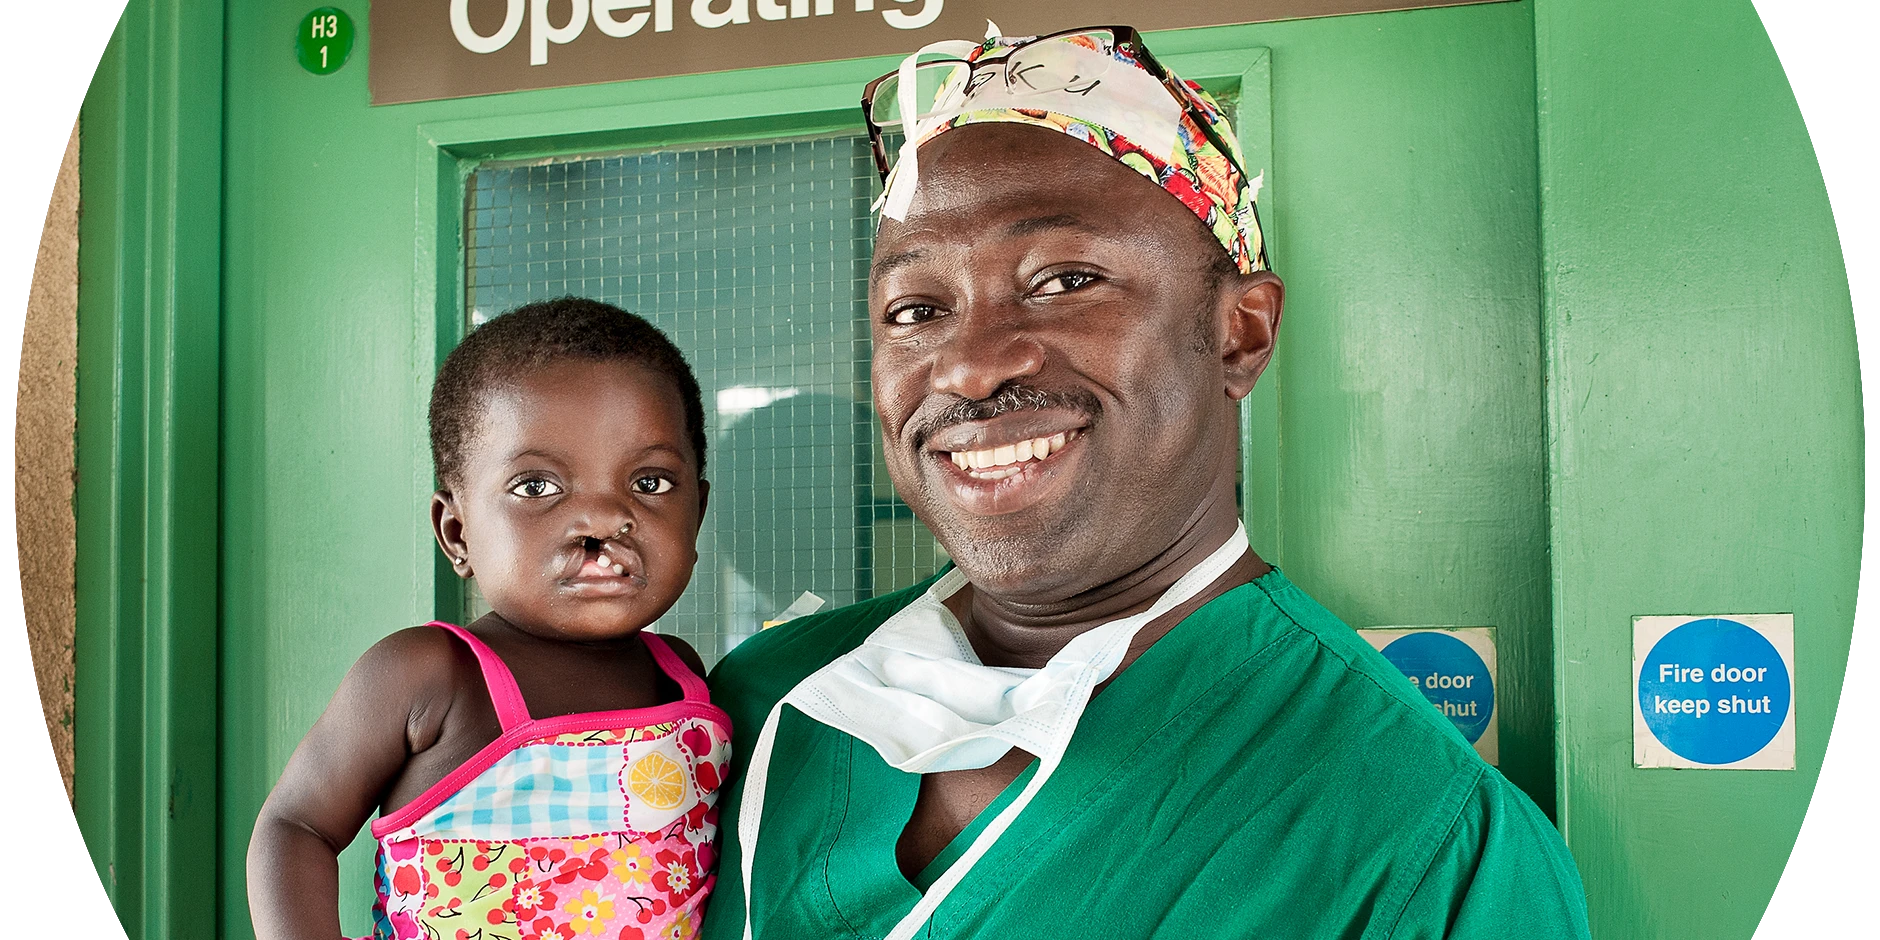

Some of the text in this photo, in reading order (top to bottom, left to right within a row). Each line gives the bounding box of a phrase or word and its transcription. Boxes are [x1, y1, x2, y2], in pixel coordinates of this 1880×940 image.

[311, 14, 338, 39] H3
[450, 0, 945, 66] Opera
[319, 45, 328, 69] 1
[1425, 672, 1475, 689] door
[1659, 663, 1768, 683] Fire door
[1654, 695, 1771, 719] keep shut
